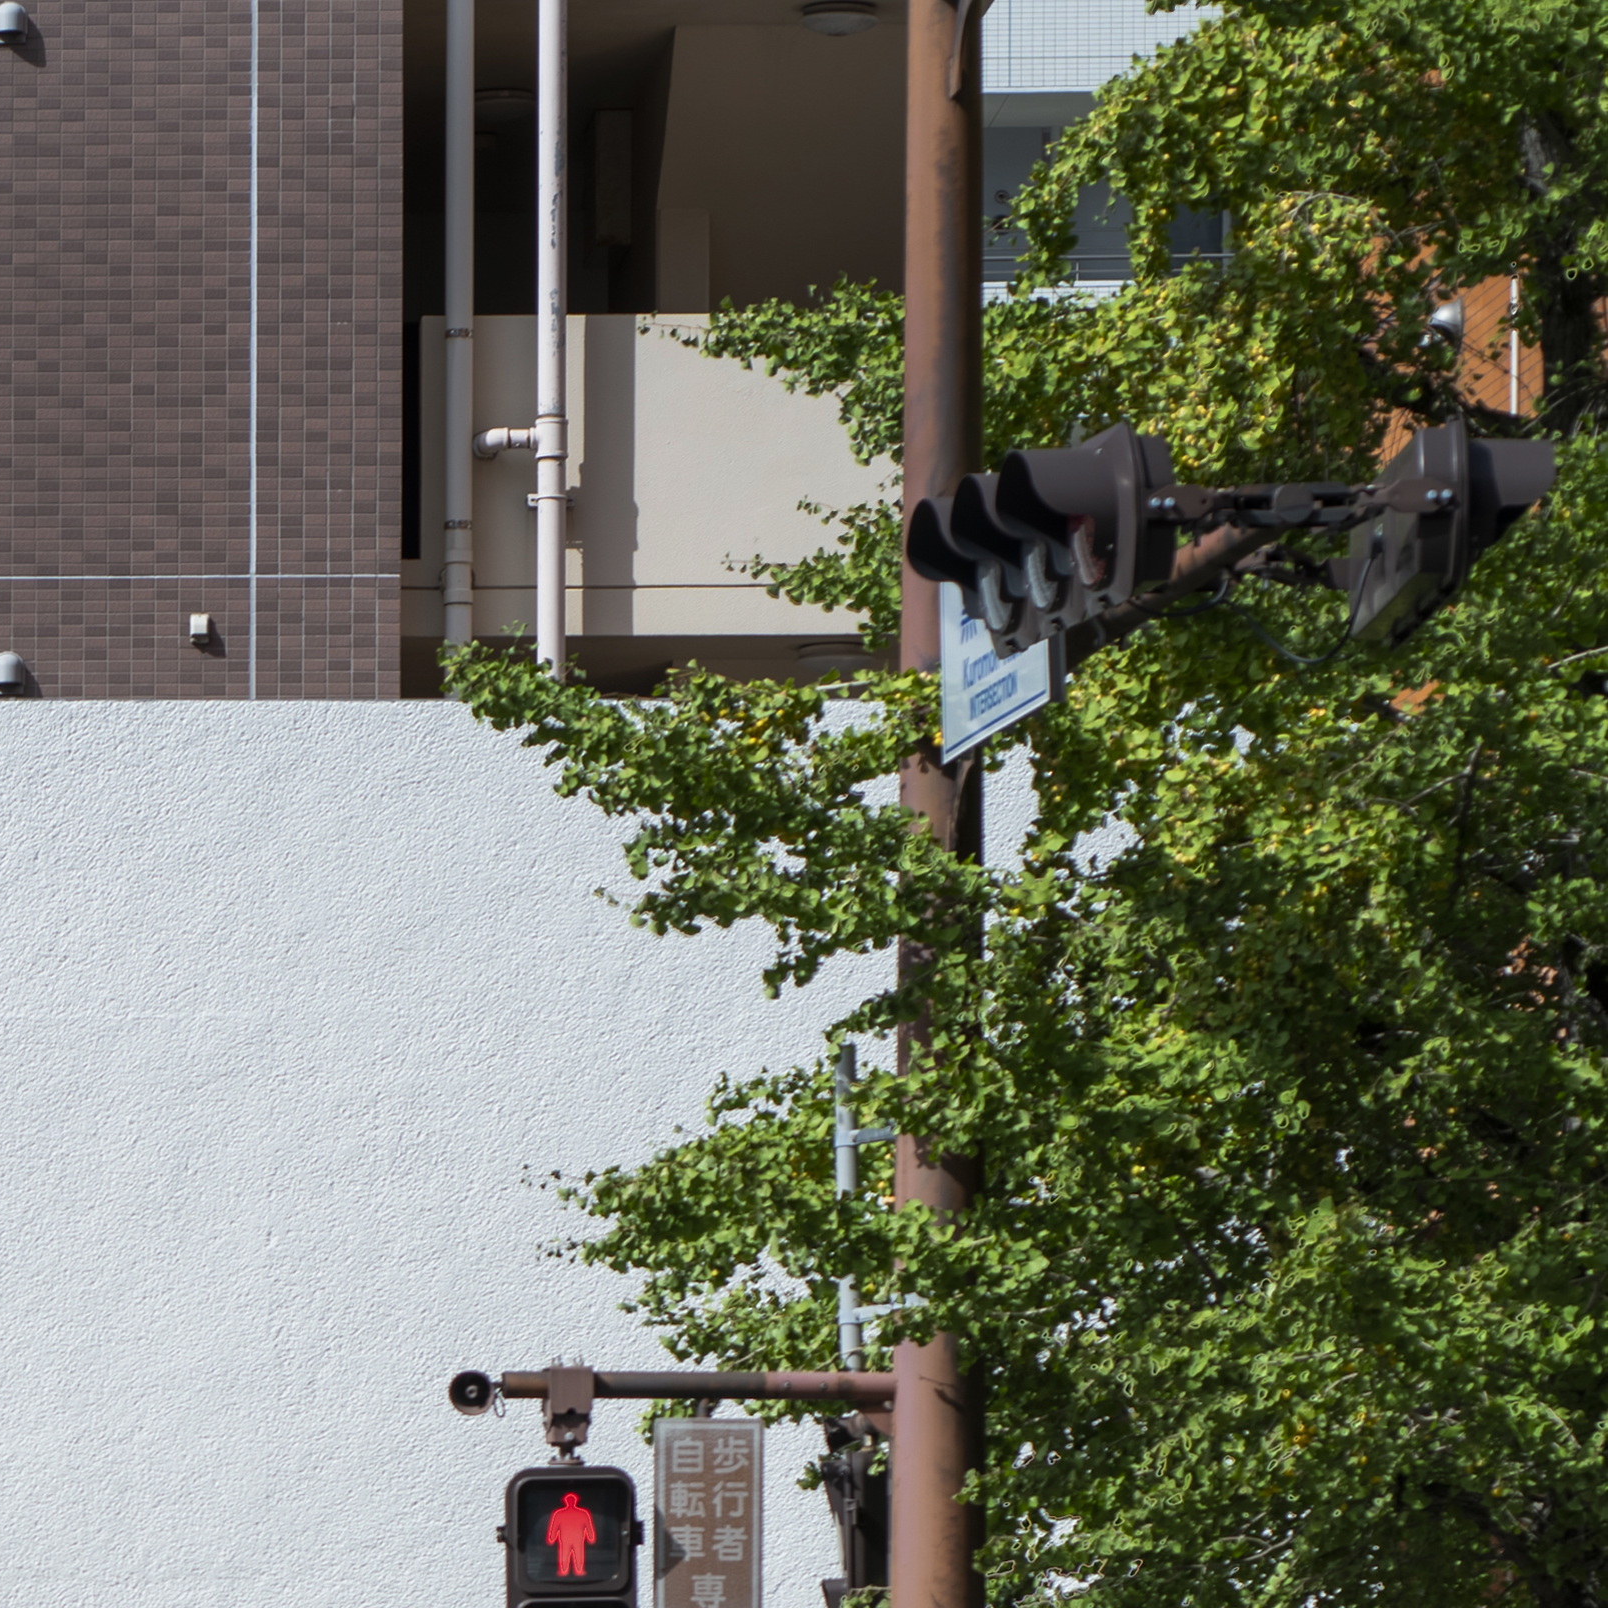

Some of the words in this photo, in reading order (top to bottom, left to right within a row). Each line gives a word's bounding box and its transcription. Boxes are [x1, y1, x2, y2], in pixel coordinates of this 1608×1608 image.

[970, 670, 1018, 721] INTERSECTION
[669, 1436, 706, 1562] 自転車
[712, 1436, 749, 1562] 歩行者
